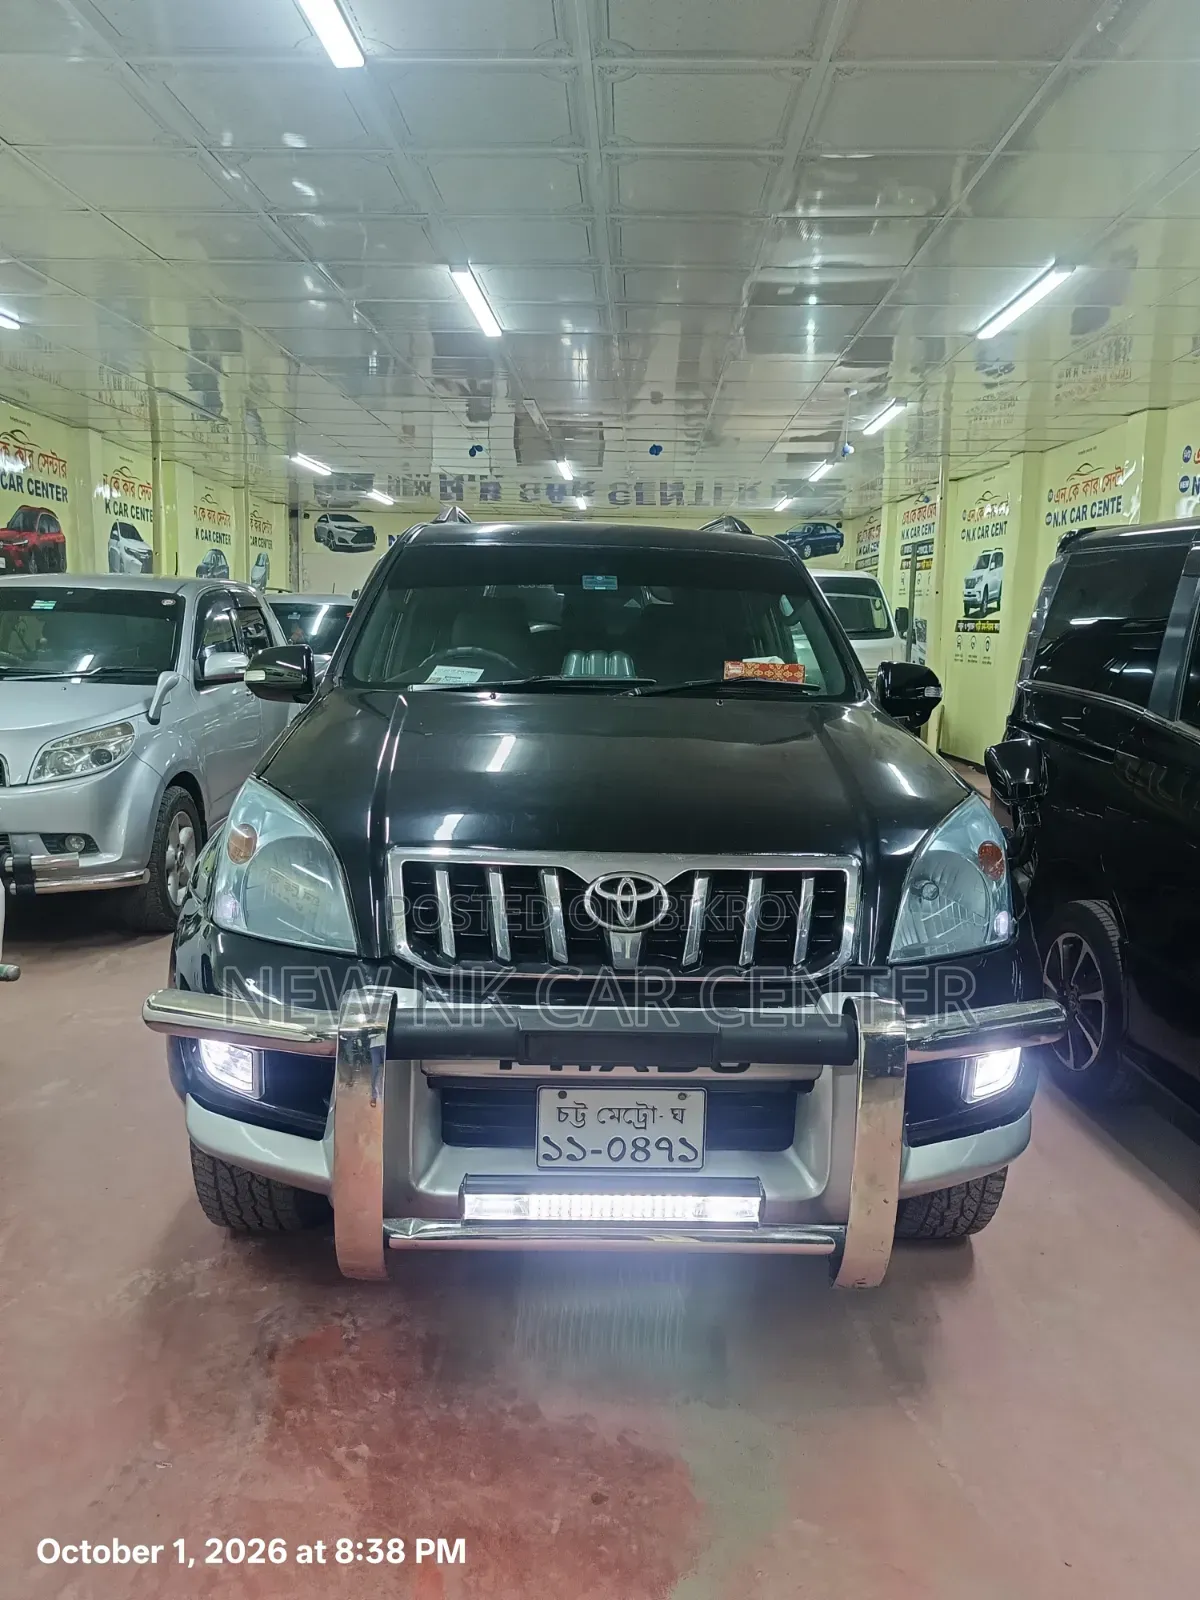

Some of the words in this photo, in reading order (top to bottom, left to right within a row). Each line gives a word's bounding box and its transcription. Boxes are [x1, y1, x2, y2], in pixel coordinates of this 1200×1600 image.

[38, 448, 67, 479] সেন্টার
[0, 471, 24, 494] CAR
[27, 478, 68, 503] CENTER
[1082, 477, 1099, 497] কার
[105, 498, 111, 514] K
[113, 501, 129, 518] CAR
[1052, 508, 1067, 528] N.K
[1070, 504, 1087, 524] CAR
[1091, 495, 1122, 519] CENTE
[201, 528, 212, 542] CAR
[213, 531, 231, 546] CENTER
[911, 525, 920, 538] CAR
[977, 525, 989, 540] CAR
[991, 520, 1008, 537] CENT
[557, 1101, 588, 1128] চট্ট
[542, 1136, 699, 1163] ১১-০৪৭১
